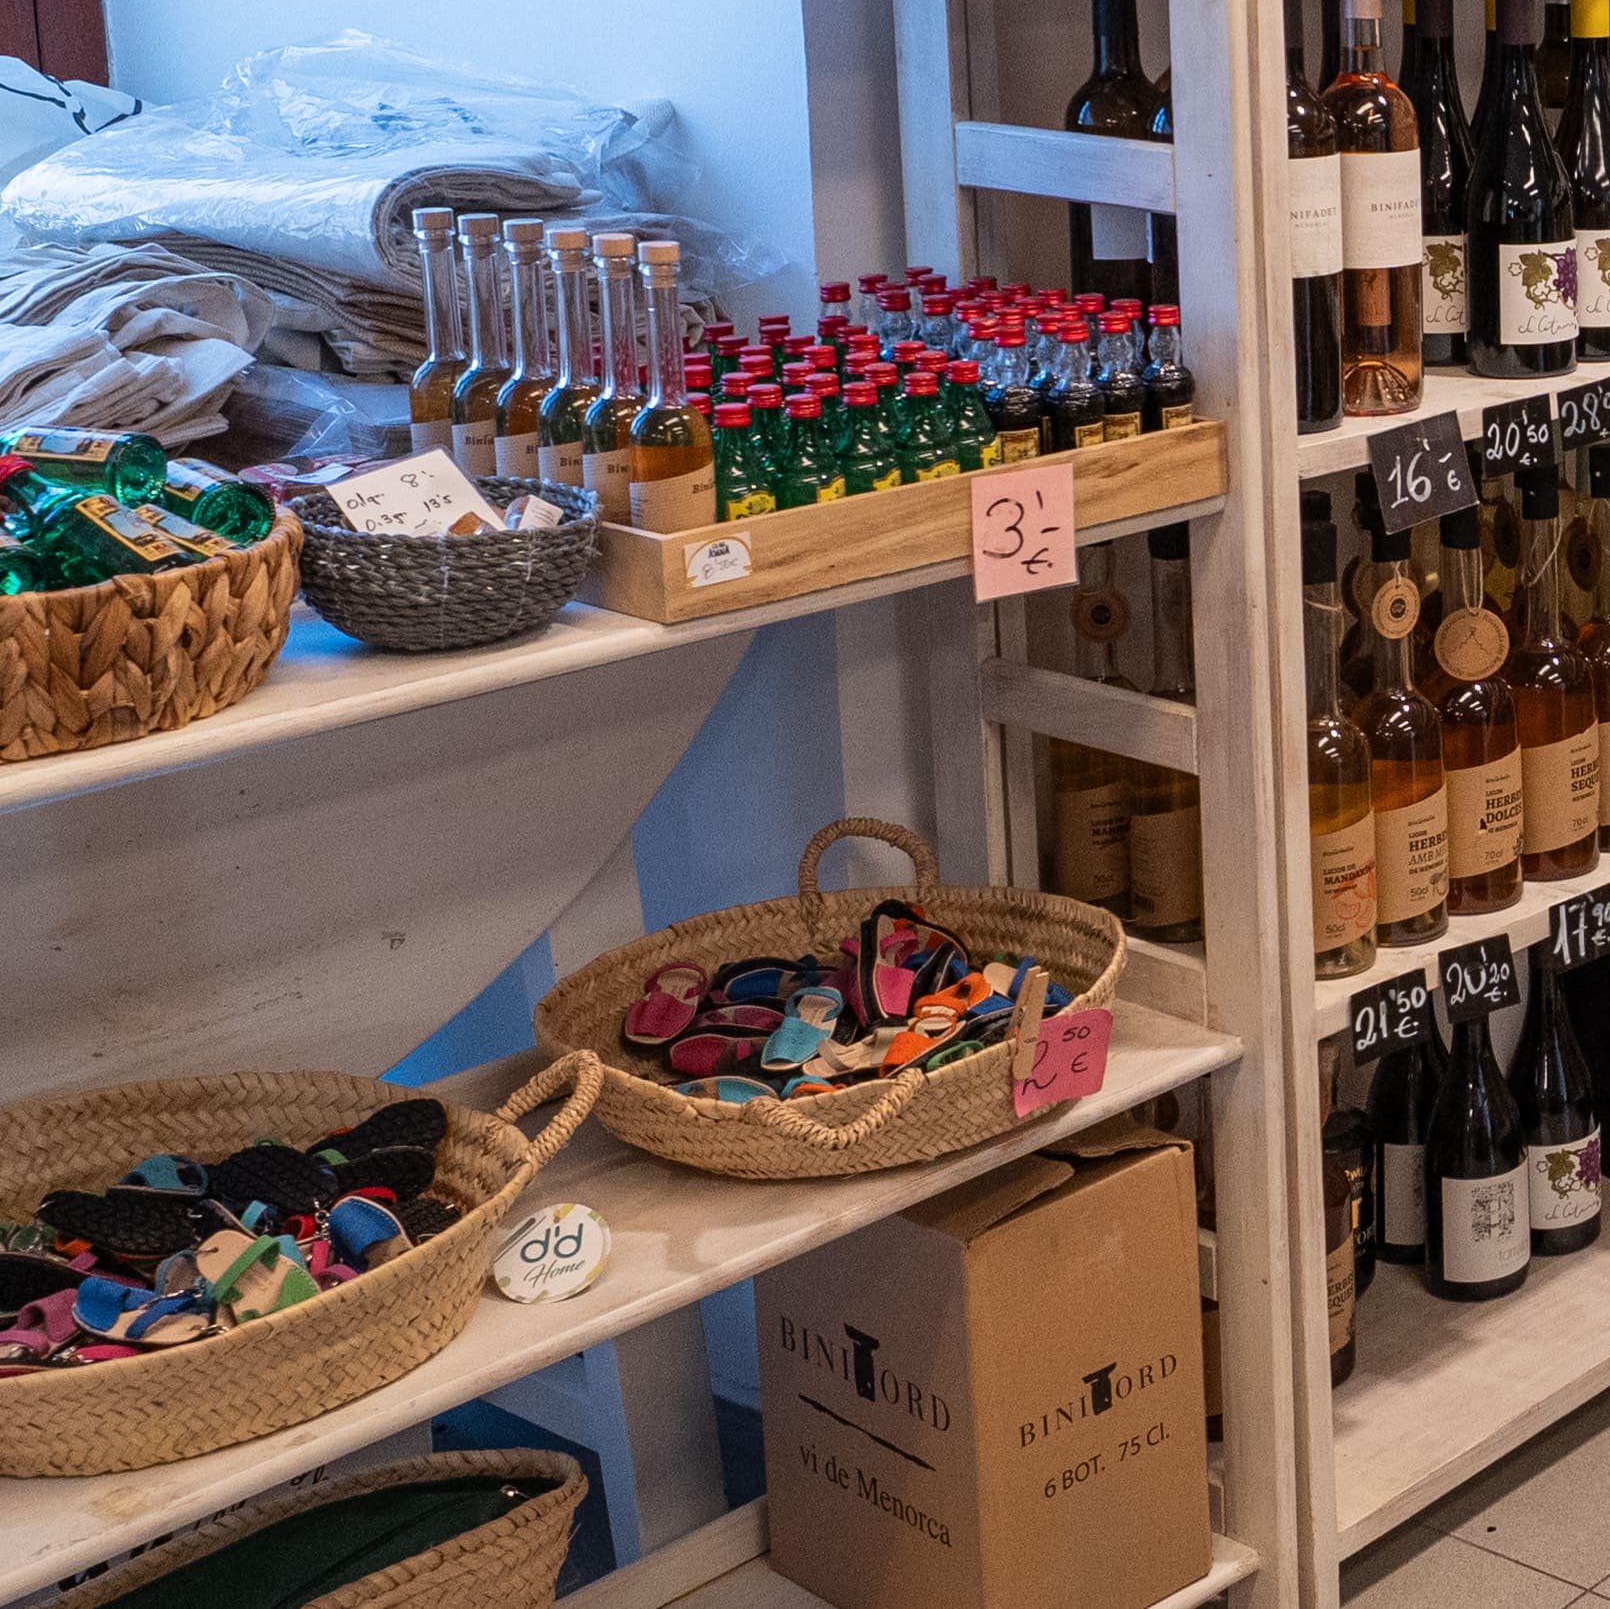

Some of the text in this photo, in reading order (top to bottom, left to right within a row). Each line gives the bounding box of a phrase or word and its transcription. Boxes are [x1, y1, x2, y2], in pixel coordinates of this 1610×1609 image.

[522, 1256, 588, 1289] Home
[1043, 1476, 1057, 1499] 6
[1061, 1454, 1107, 1492] BOT.
[1117, 1436, 1143, 1463] 75
[825, 1454, 849, 1489] de
[856, 1470, 953, 1548] Menorca
